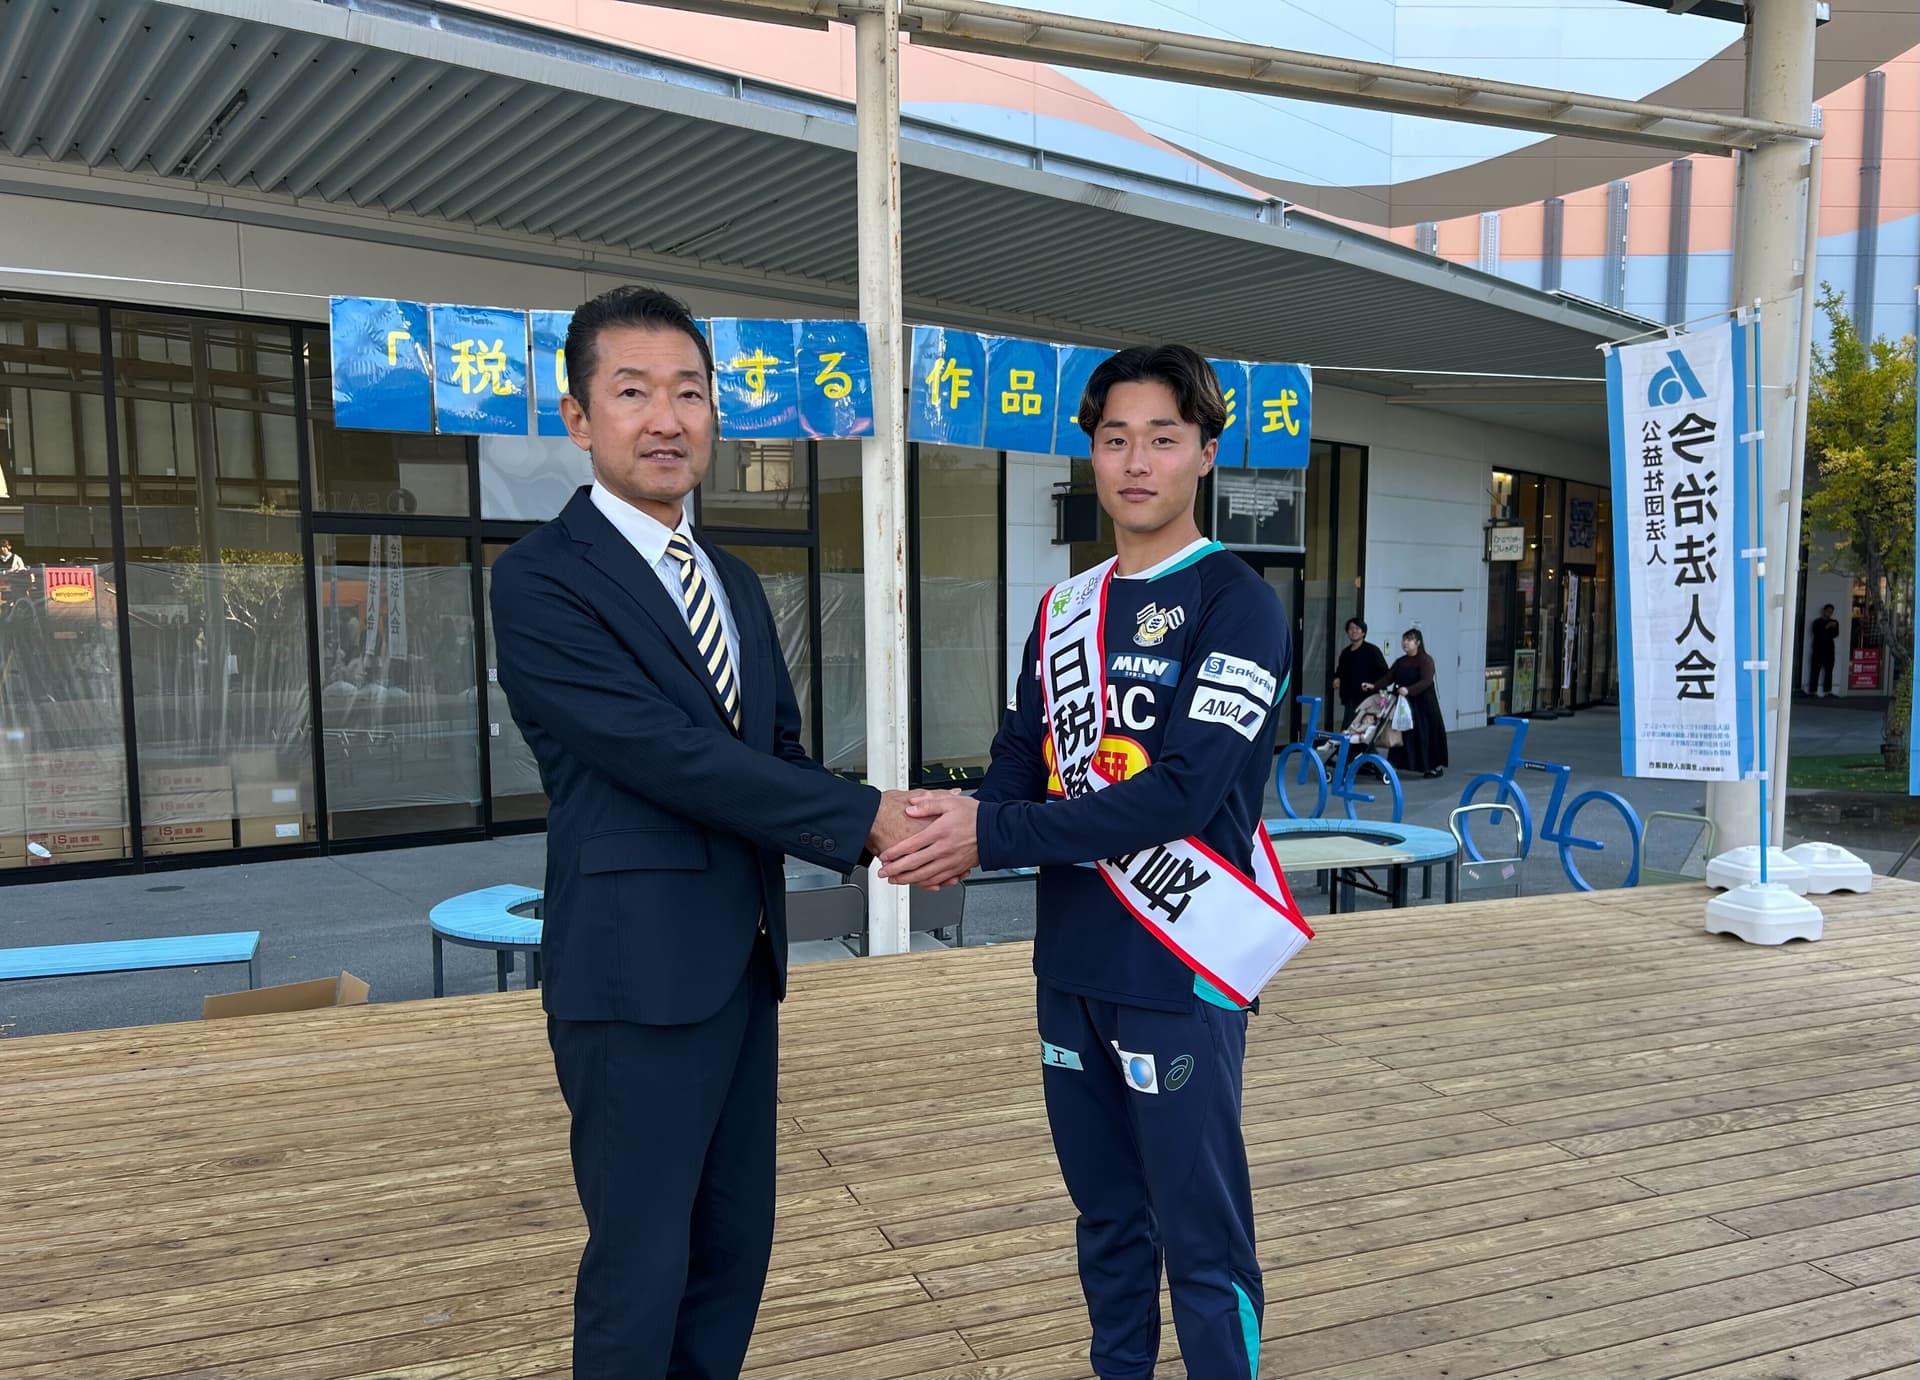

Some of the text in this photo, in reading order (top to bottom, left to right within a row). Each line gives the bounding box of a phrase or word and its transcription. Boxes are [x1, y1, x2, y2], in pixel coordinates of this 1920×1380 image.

[733, 349, 853, 400] する
[1111, 655, 1170, 677] MIW
[1226, 665, 1274, 694] SAKURAI
[1198, 698, 1242, 722] ANA
